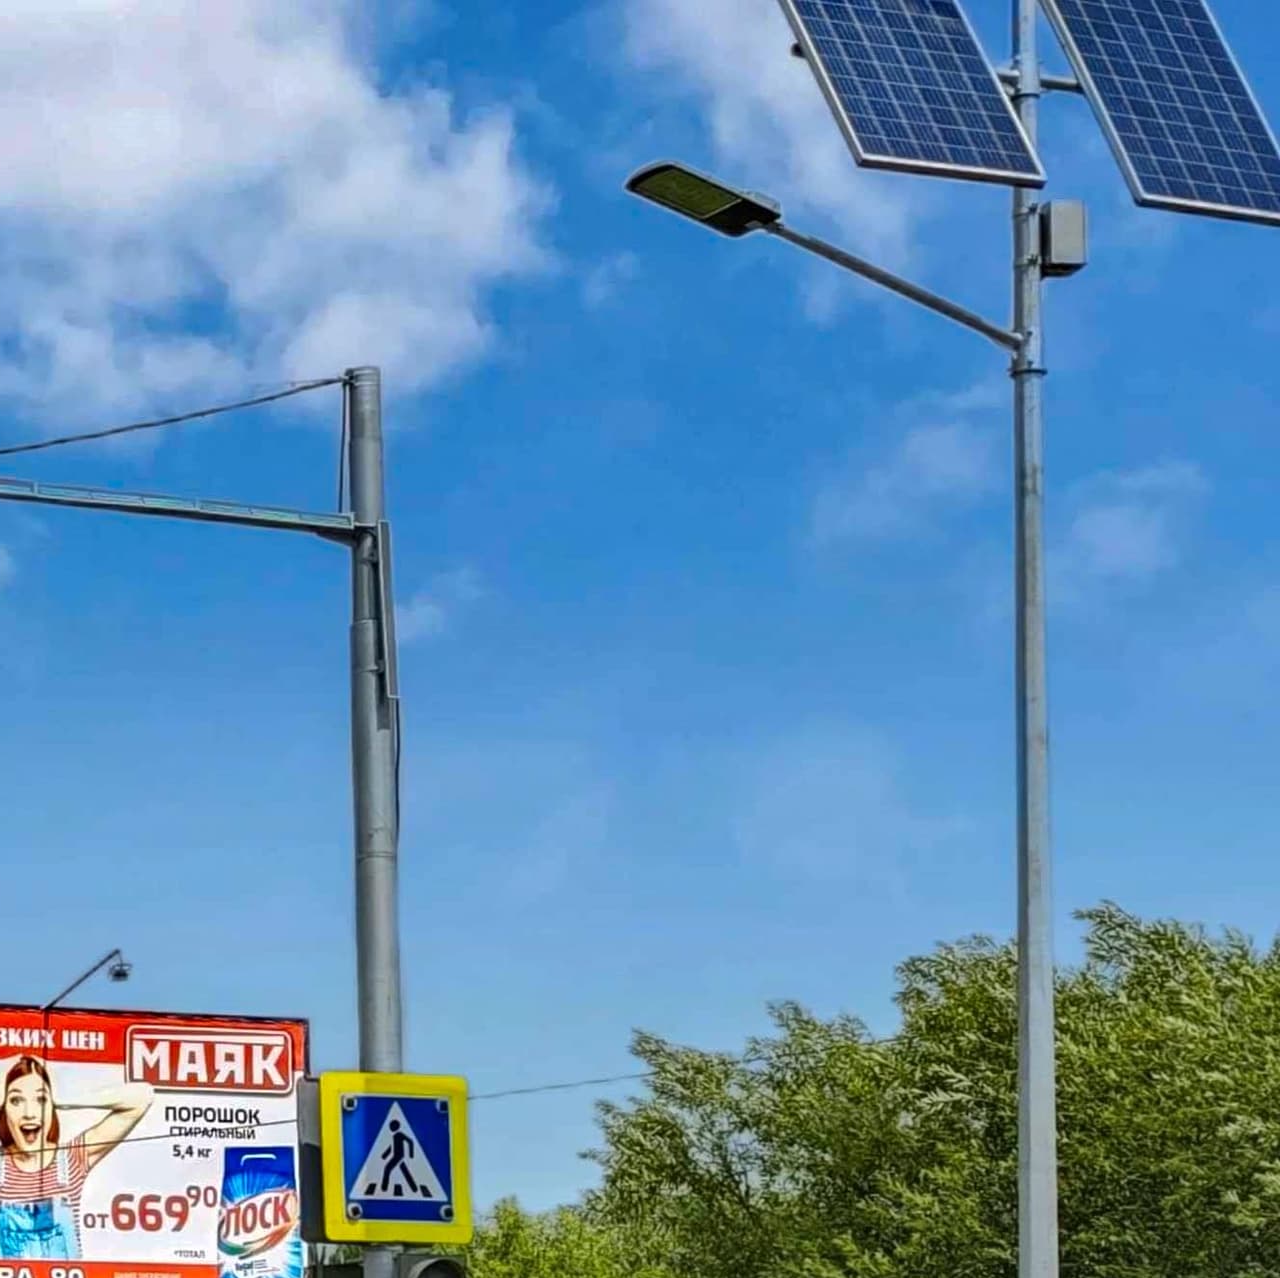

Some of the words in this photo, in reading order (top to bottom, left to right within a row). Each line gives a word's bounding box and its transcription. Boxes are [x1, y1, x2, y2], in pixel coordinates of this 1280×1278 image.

[62, 1029, 105, 1051] ЦЕН
[132, 1037, 287, 1087] МАЯК
[164, 1106, 261, 1124] ПОРОШОК
[170, 1125, 256, 1140] СТИРАЛЬНЫЙ
[173, 1144, 194, 1159] 5,4
[197, 1147, 212, 1159] кг
[223, 1193, 292, 1239] ЛОСК
